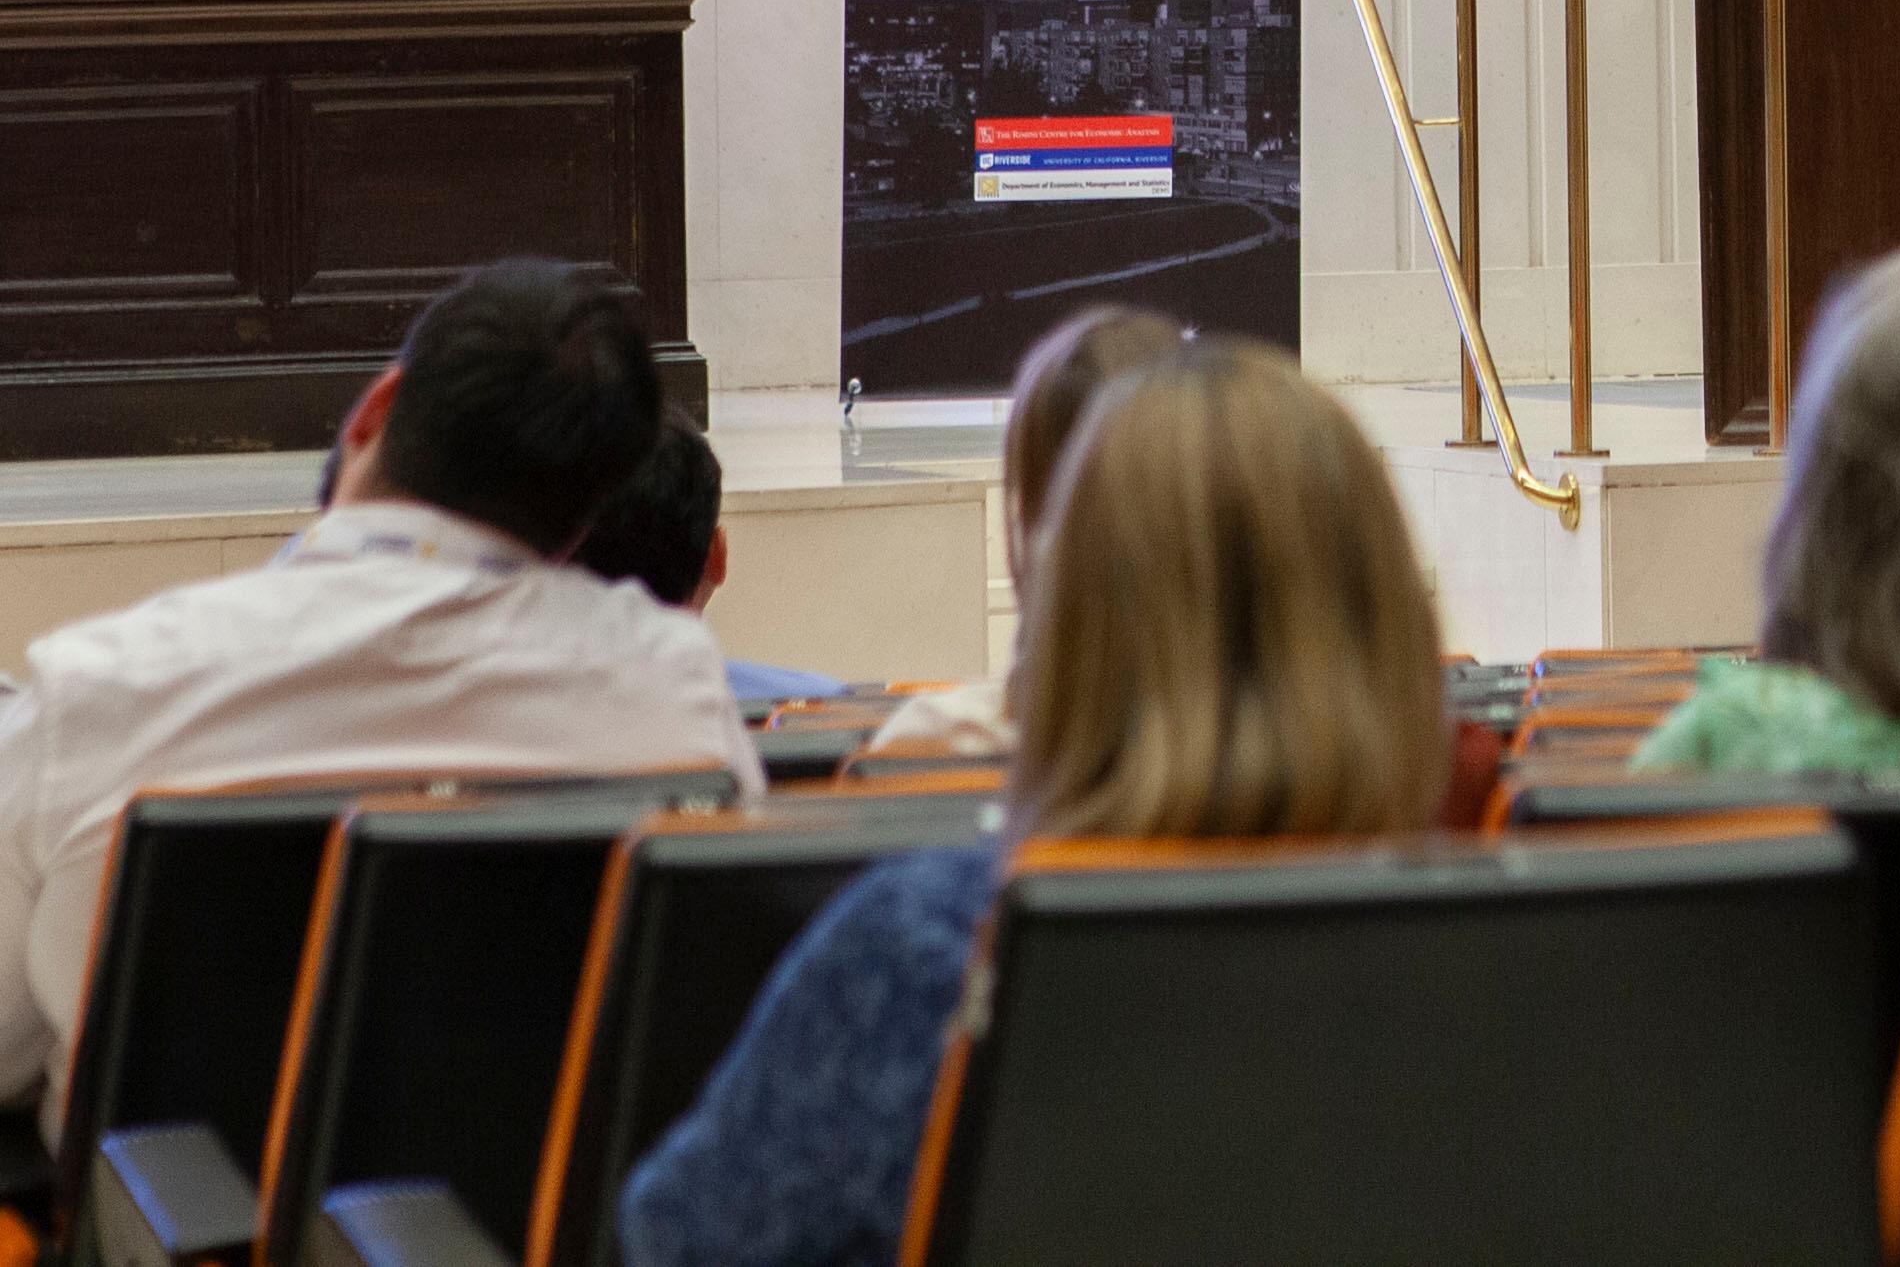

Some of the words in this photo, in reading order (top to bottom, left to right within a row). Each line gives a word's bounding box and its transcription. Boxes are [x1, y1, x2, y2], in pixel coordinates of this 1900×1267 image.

[994, 155, 1032, 166] RIVERSIDE
[1002, 182, 1040, 191] Department
[1085, 180, 1127, 189] Management
[1128, 179, 1139, 187] and
[1142, 178, 1170, 187] Statistics
